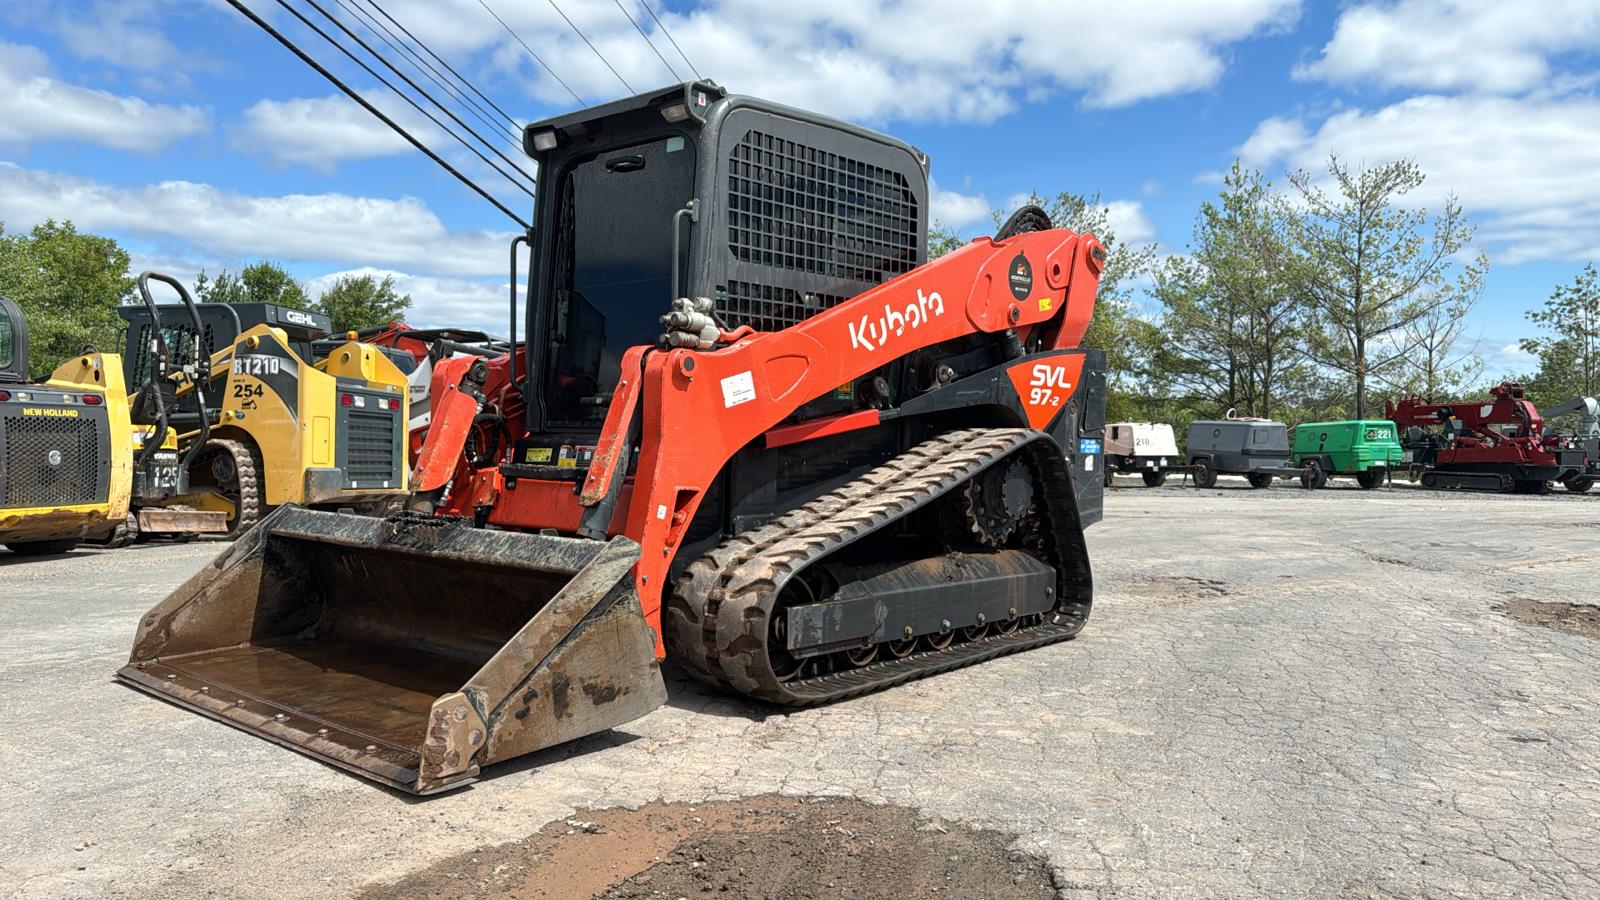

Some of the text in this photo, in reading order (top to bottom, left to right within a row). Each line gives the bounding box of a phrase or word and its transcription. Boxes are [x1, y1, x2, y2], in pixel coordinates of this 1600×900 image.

[287, 311, 317, 326] GEHL
[848, 288, 945, 352] Kubota
[234, 358, 279, 375] RT210
[1030, 364, 1072, 389] SVL
[233, 384, 264, 398] 254
[23, 408, 78, 417] NEW HOLLAND
[1377, 430, 1392, 439] 221
